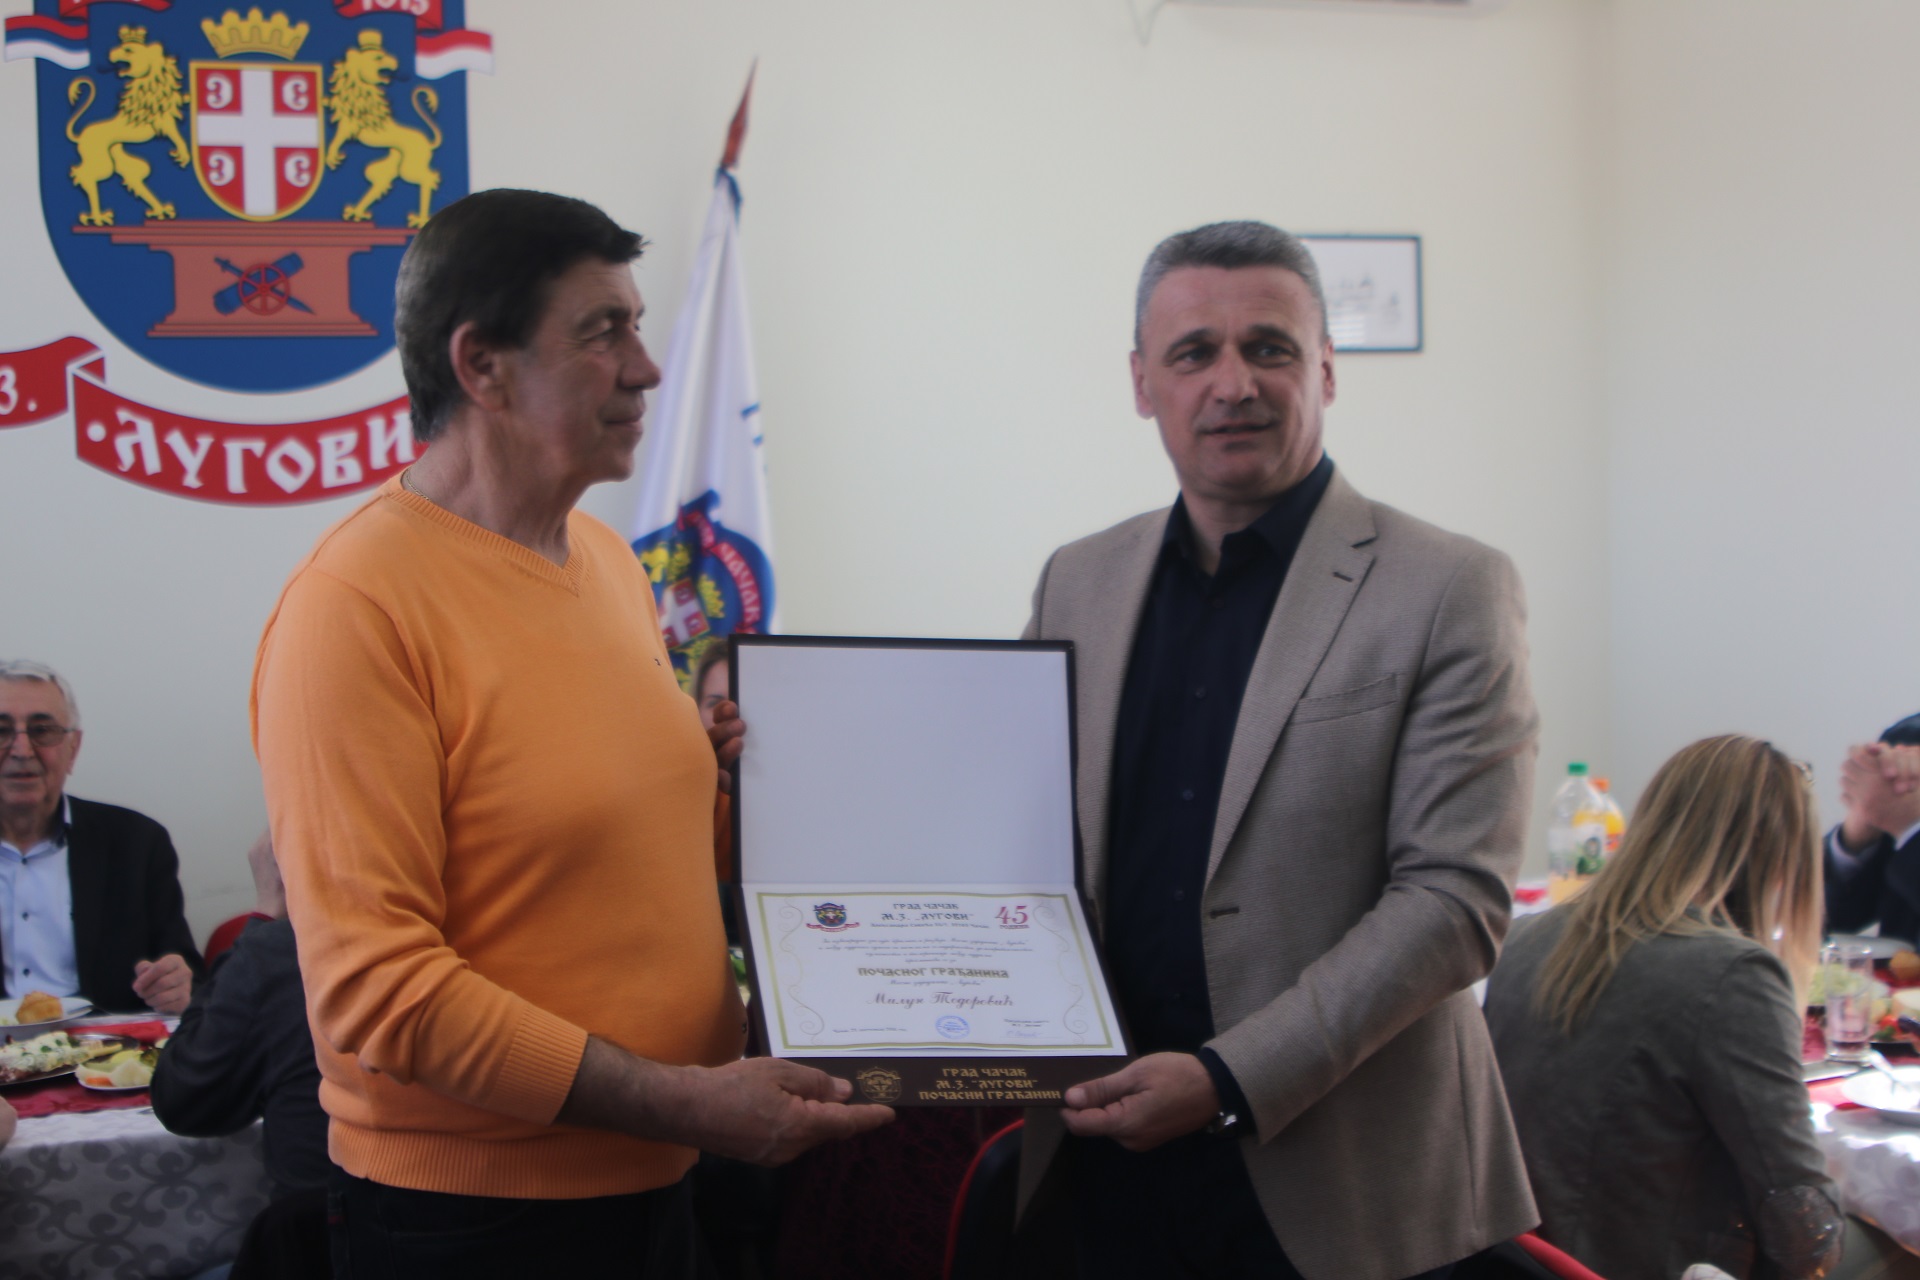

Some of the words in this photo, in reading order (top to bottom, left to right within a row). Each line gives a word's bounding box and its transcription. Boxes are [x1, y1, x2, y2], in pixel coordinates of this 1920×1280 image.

[893, 903, 921, 911] ГРАД
[923, 903, 959, 911] ЧАЧАК
[994, 905, 1028, 925] 45
[858, 967, 926, 977] ПОЧАСНОГ
[942, 1068, 979, 1077] ГРАД
[981, 1068, 1028, 1077] ЧАЧАК
[919, 1091, 985, 1100] ПОЧАСНИ
